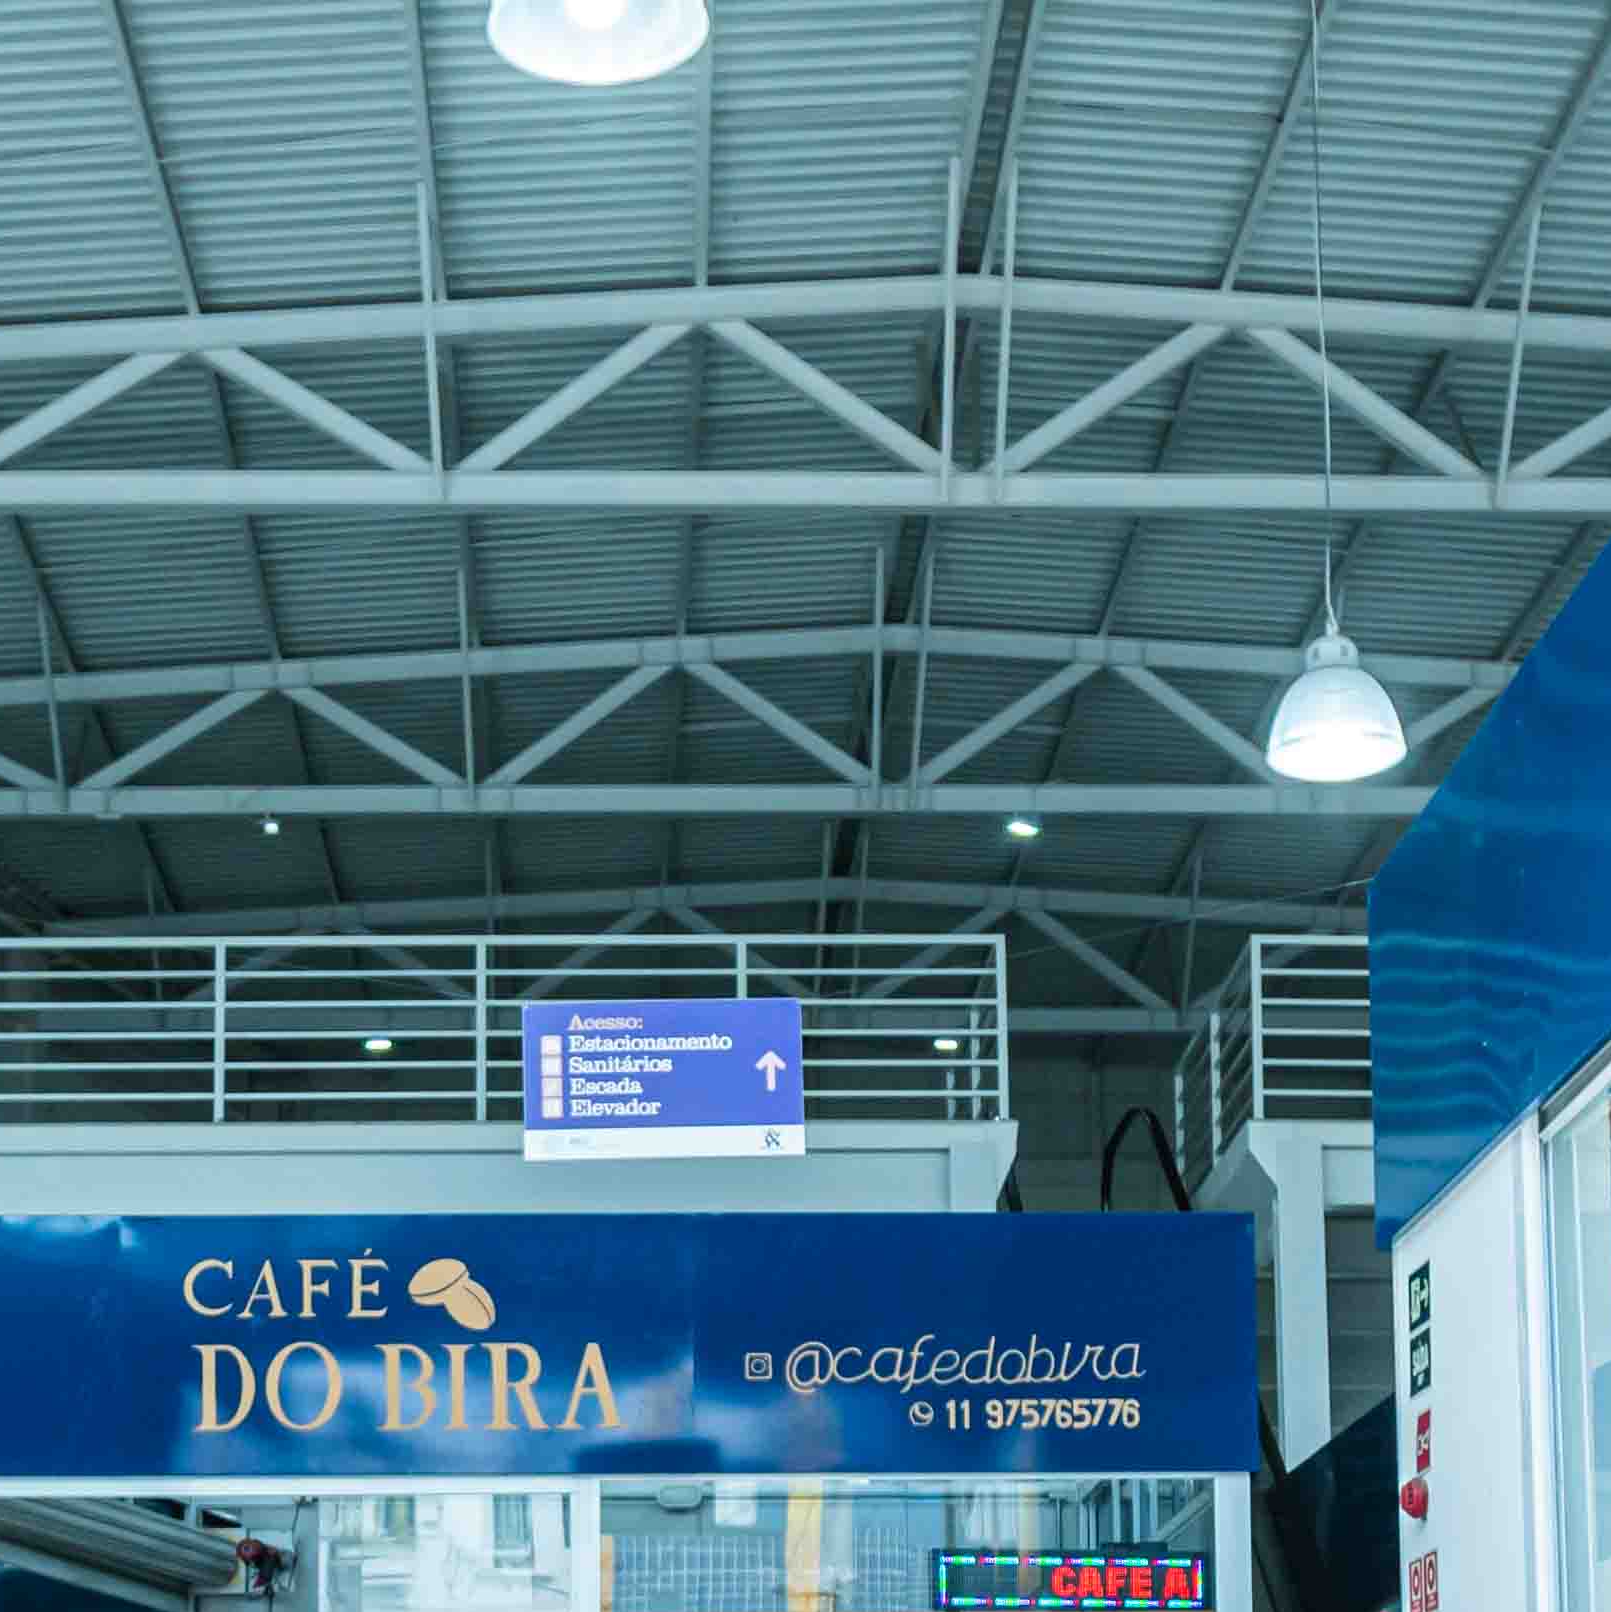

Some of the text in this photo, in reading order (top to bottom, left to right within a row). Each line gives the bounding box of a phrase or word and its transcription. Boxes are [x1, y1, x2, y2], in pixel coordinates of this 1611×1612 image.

[567, 1013, 643, 1031] Acesso:
[569, 1033, 732, 1052] Estacionamento
[569, 1055, 673, 1073] Sanitários
[569, 1077, 643, 1095] Escada
[570, 1098, 661, 1116] Elevador
[183, 1248, 389, 1319] CAFÉ
[786, 1334, 1146, 1394] @cafedobira
[191, 1341, 627, 1432] DO BIRA
[945, 1399, 1140, 1430] 11 975765776
[1051, 1565, 1153, 1599] CAFE
